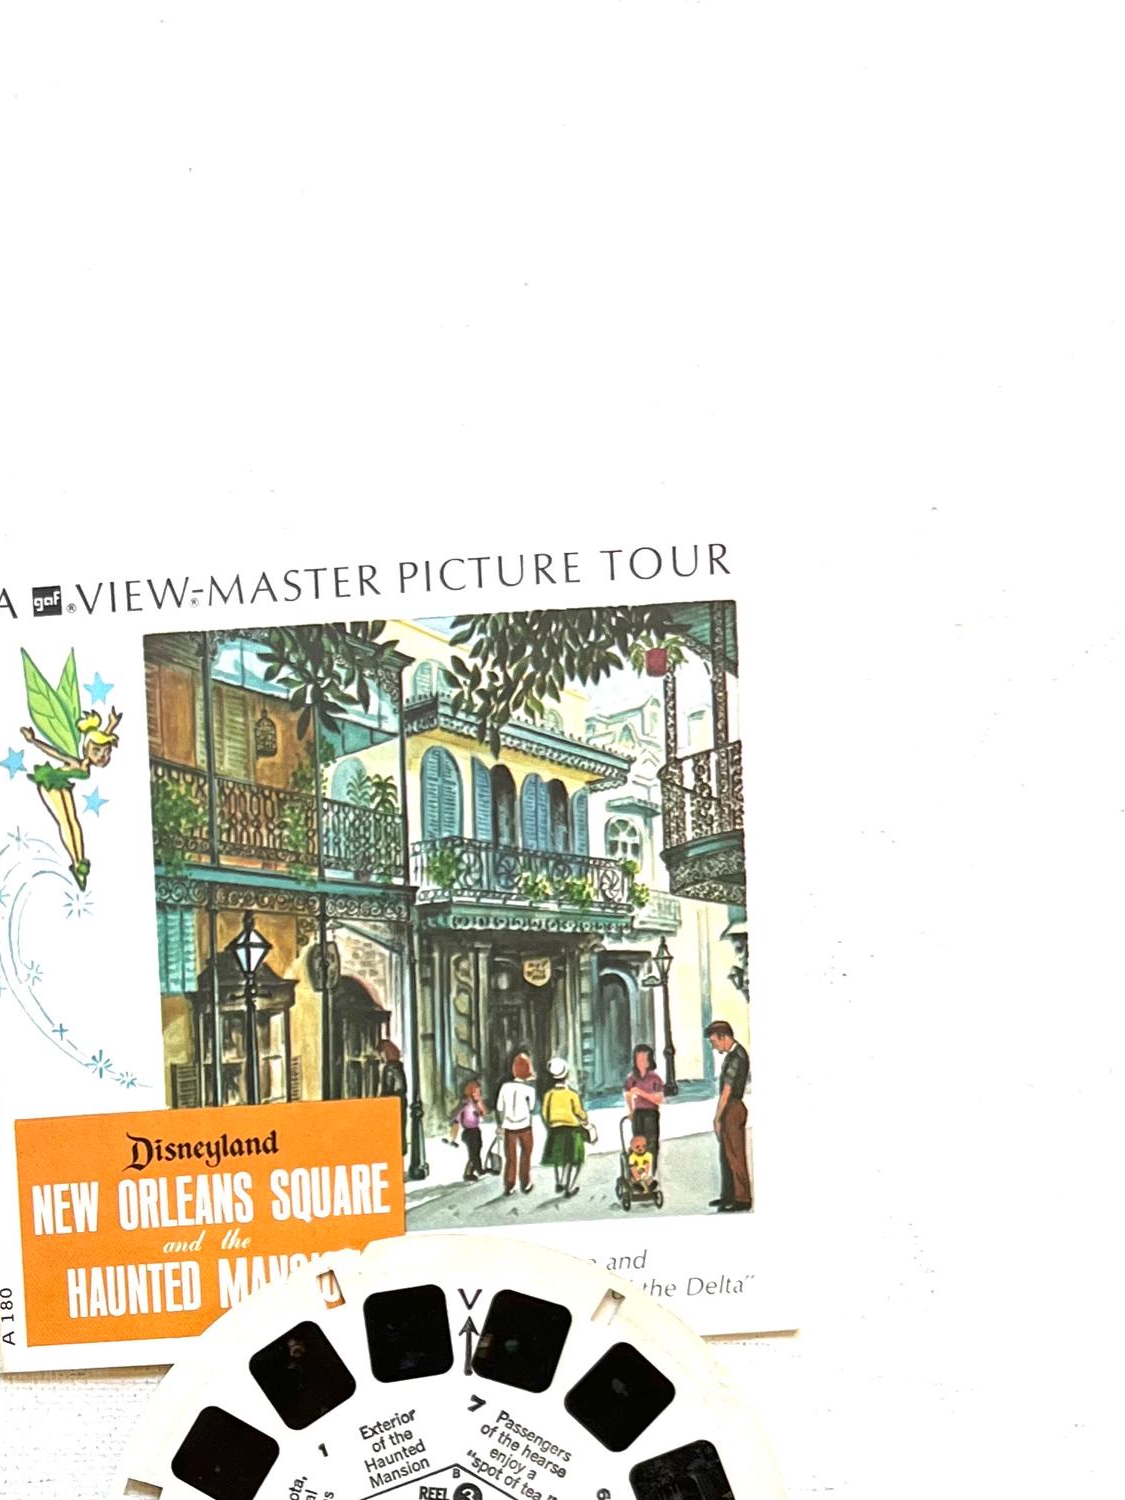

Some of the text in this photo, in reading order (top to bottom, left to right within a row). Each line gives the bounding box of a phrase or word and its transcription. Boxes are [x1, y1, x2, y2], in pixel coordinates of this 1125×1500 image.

[33, 590, 62, 612] gaf
[399, 552, 581, 594] PICTURE
[600, 543, 732, 581] TOUR
[123, 1131, 278, 1171] Disneyland
[32, 1163, 391, 1235] NEW ORLEANS SQUARE
[163, 1229, 251, 1253] and the
[606, 1249, 647, 1271] and
[67, 1260, 201, 1319] HAUNTED
[0, 1288, 15, 1345] A 180
[359, 1409, 416, 1440] Exterior
[372, 1429, 413, 1452] of the
[496, 1410, 572, 1462] Passengers
[364, 1439, 426, 1473] Haunted
[480, 1424, 567, 1478] of the hearse
[489, 1448, 537, 1480] enjoy a
[369, 1457, 430, 1488] Mansion
[504, 1475, 521, 1489] of
